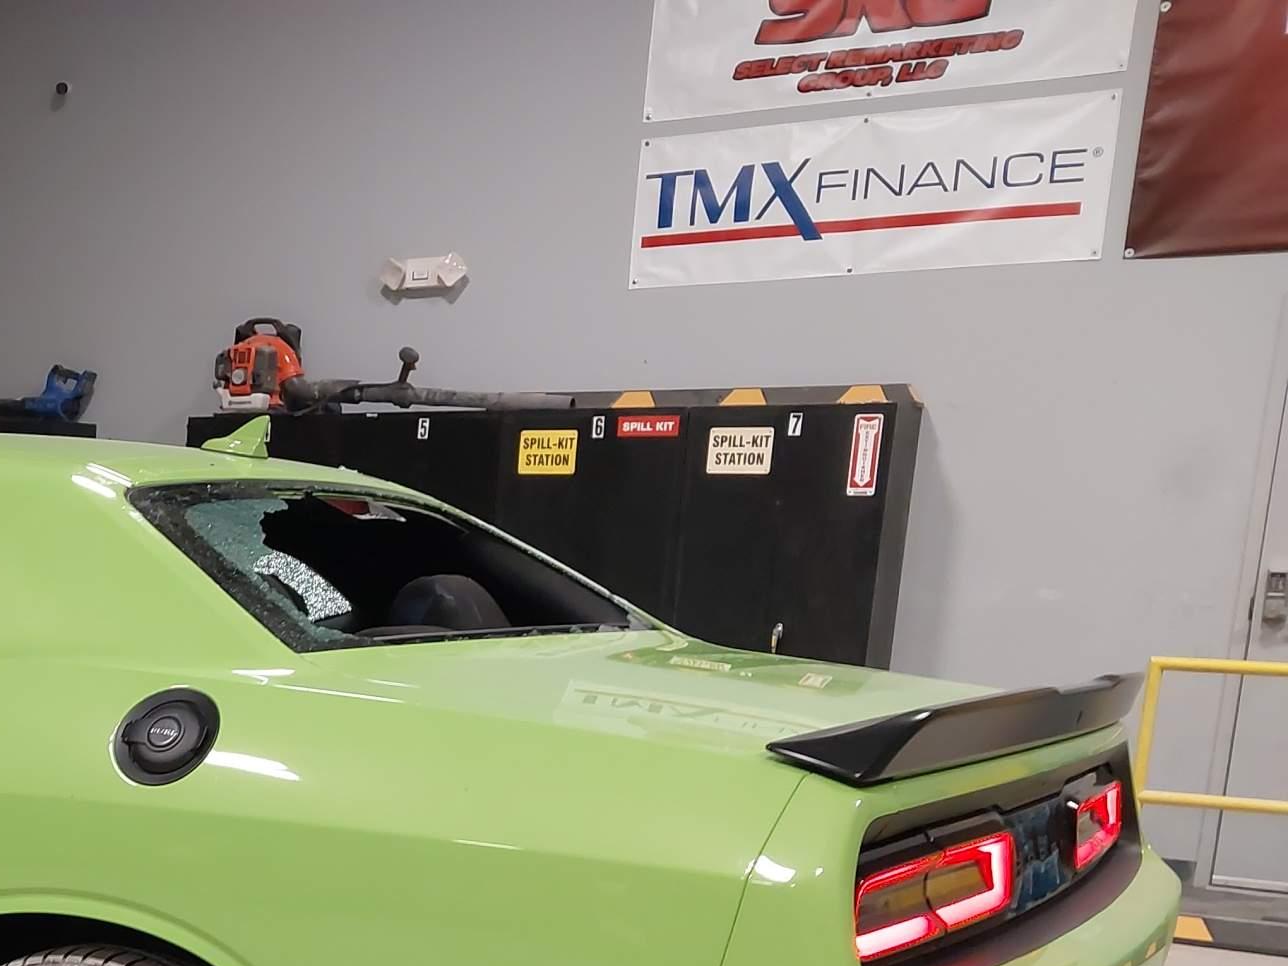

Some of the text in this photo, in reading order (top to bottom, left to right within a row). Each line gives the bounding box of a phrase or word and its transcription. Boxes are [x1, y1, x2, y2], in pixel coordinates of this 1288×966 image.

[732, 29, 1024, 80] SELECT REMARKETING
[797, 59, 950, 93] GROUP, LLC
[646, 157, 823, 241] TMX
[419, 419, 428, 438] 5
[594, 417, 604, 437] 6
[622, 421, 675, 432] SPILL KIT
[791, 414, 802, 434] 7
[523, 437, 576, 450] SPILL-KIT
[712, 435, 772, 448] SPILL-KIT
[525, 453, 570, 466] STATION
[714, 452, 765, 466] STATION
